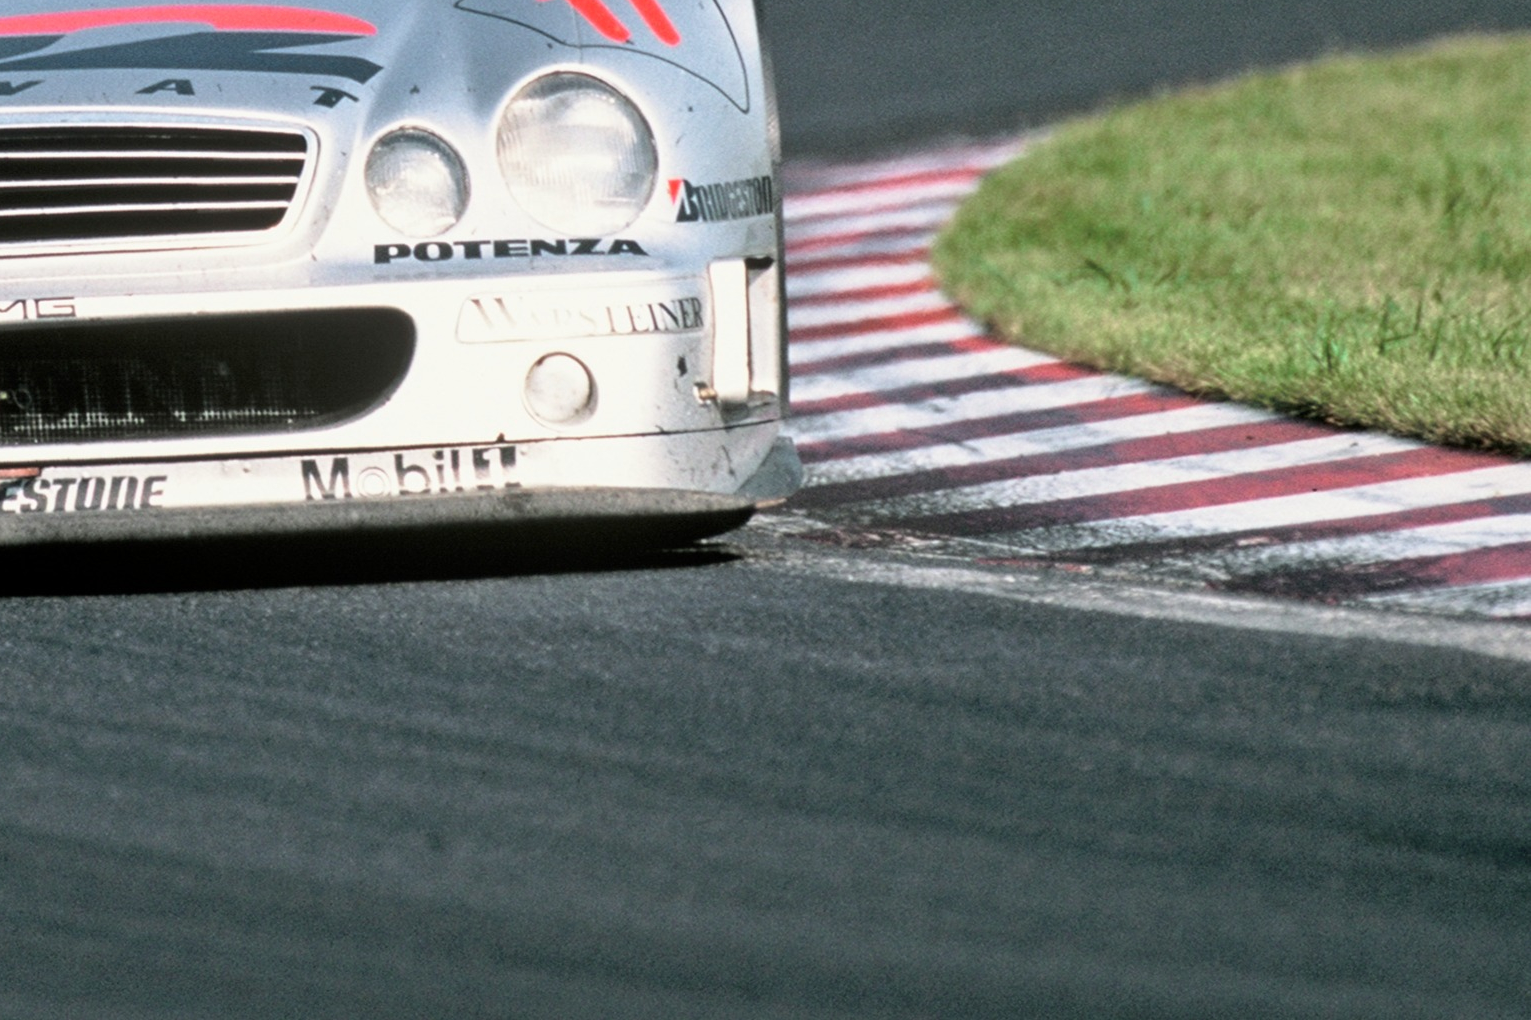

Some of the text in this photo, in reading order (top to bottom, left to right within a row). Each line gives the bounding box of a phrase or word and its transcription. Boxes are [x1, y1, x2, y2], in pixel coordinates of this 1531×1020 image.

[675, 176, 773, 222] BRIDGESTON
[373, 238, 649, 264] POTENZA
[301, 449, 464, 500] Mobil
